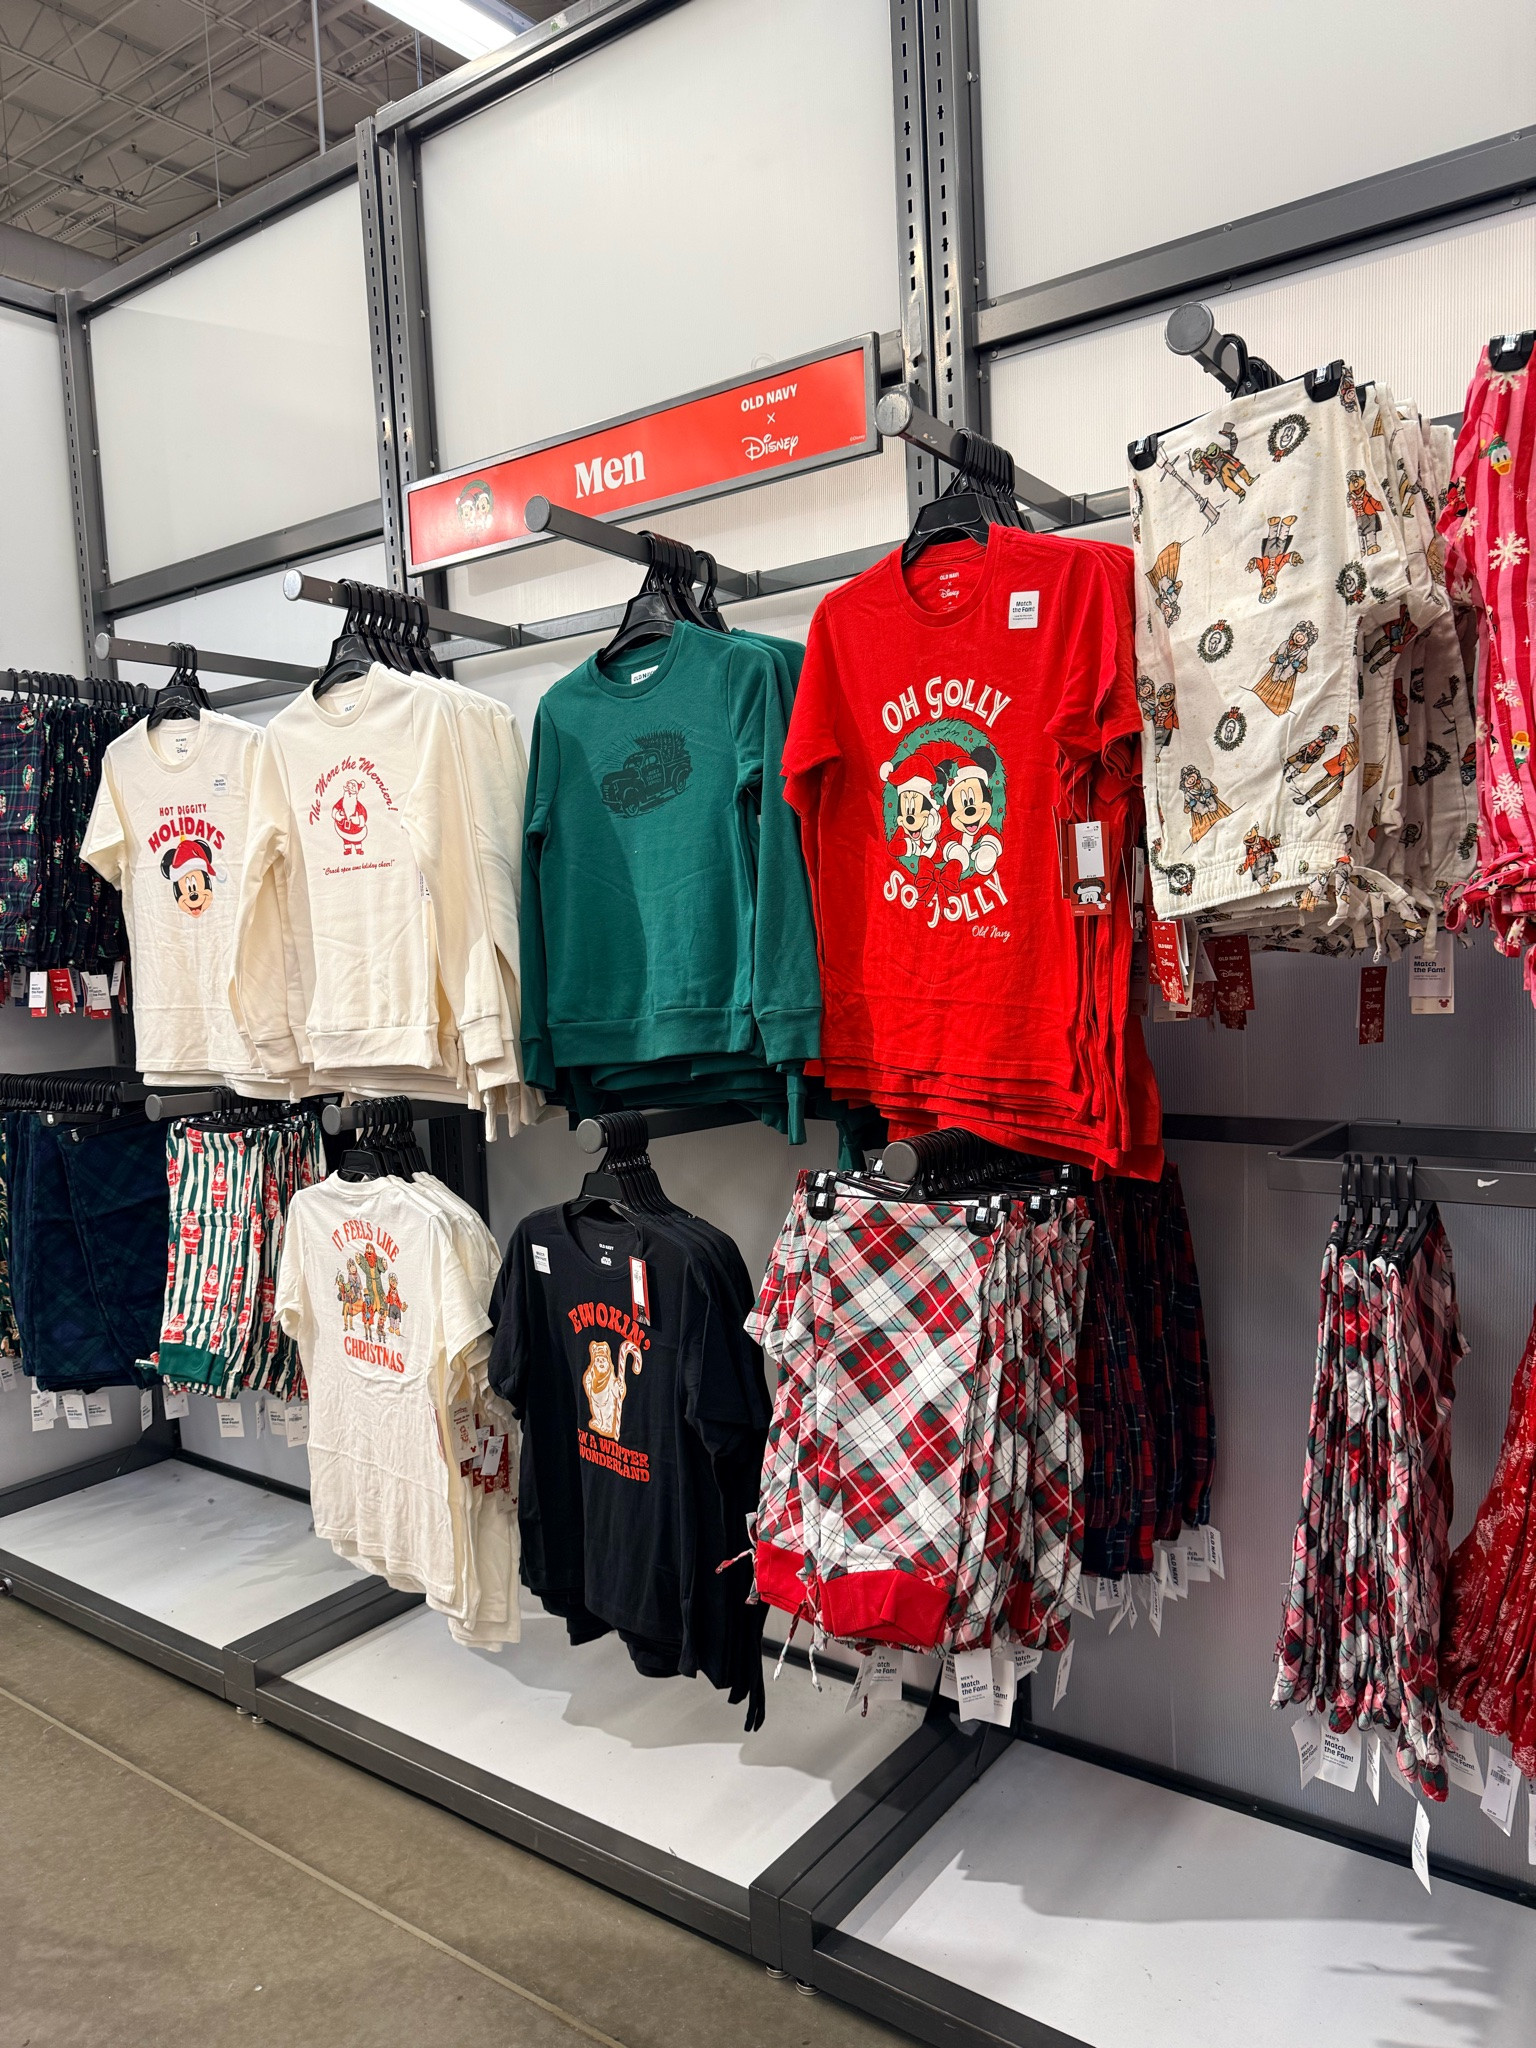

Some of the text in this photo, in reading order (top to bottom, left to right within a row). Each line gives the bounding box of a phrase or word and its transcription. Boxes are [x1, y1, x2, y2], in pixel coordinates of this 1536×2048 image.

[740, 384, 797, 412] OLD NAVY
[741, 434, 798, 461] Disney
[574, 450, 646, 499] Men
[882, 676, 1012, 734] OH GOLLY
[309, 755, 399, 825] The More the Merrier!
[159, 803, 207, 816] HOT DIGGITY
[148, 816, 225, 854] HOLIDAYS
[883, 870, 1008, 929] SO JOLLY
[971, 925, 1011, 943] Old Navy
[331, 1219, 399, 1263] IT FEELS LIKE
[344, 1335, 405, 1374] CHRISTMAS
[579, 1444, 650, 1483] WONDERLAND
[589, 1434, 597, 1449] A
[598, 1437, 649, 1468] WINTER
[961, 1680, 980, 1689] Match
[973, 1684, 988, 1693] Fam!
[1324, 1740, 1346, 1752] Match
[1324, 1746, 1336, 1755] the
[1337, 1751, 1354, 1762] Fam!
